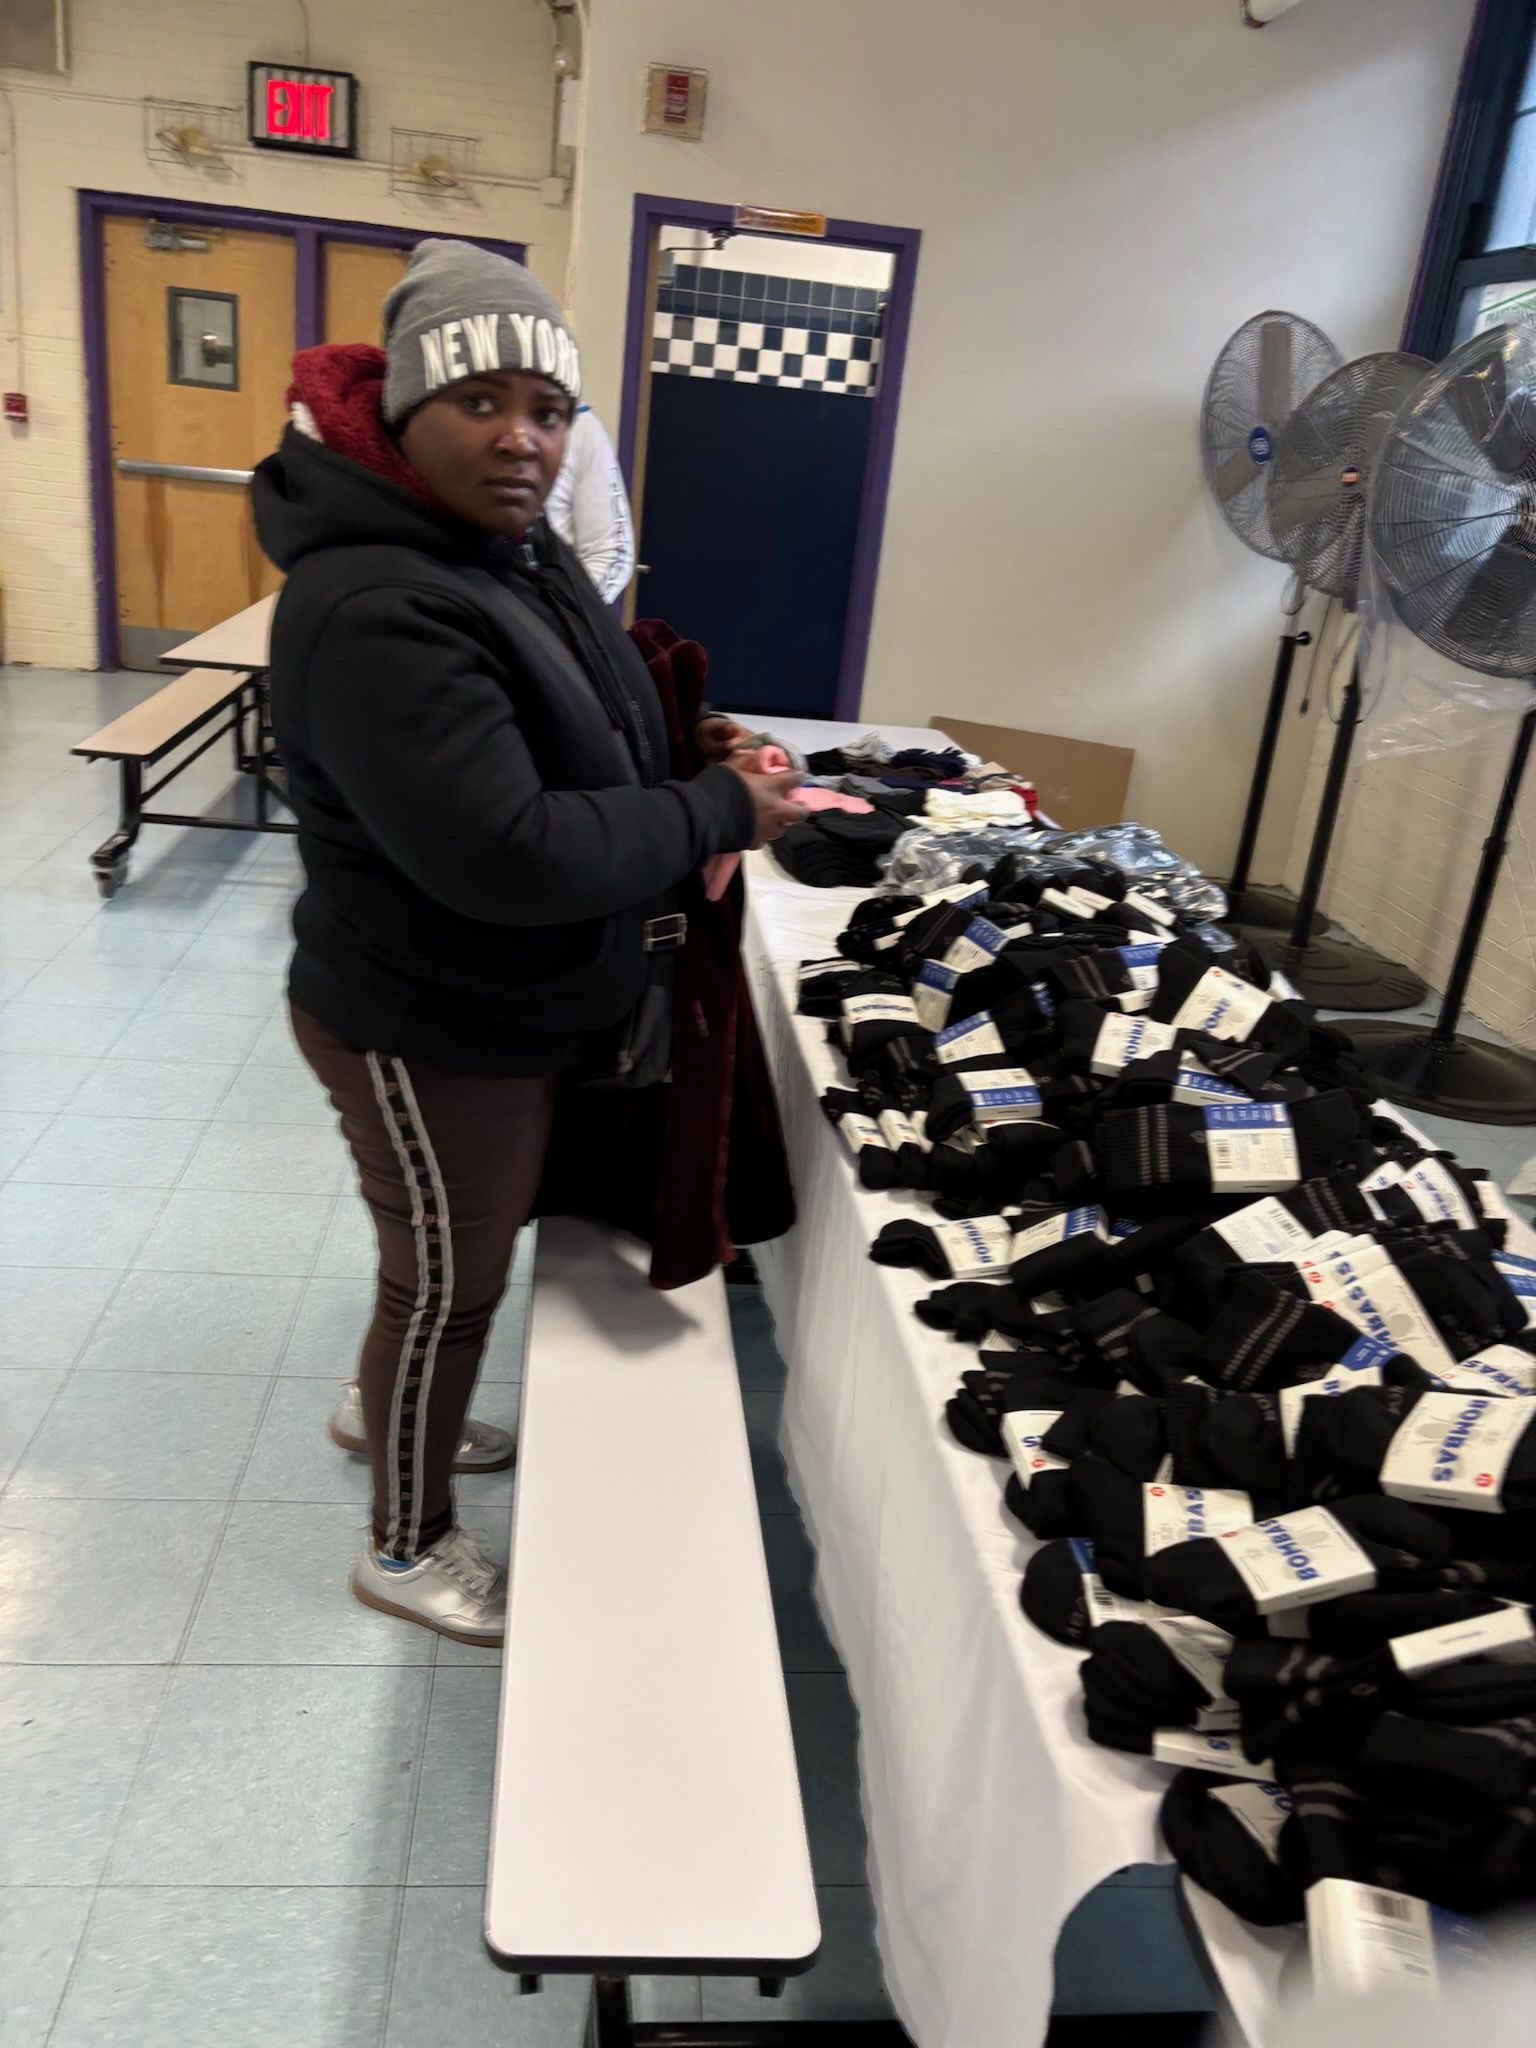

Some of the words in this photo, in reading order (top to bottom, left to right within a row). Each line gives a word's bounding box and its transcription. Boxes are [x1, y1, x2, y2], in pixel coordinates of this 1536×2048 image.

[267, 80, 333, 139] EXIT
[419, 314, 499, 389] NEW
[1431, 1400, 1489, 1482] BOMBAS
[1258, 1518, 1321, 1581] BOMBAS
